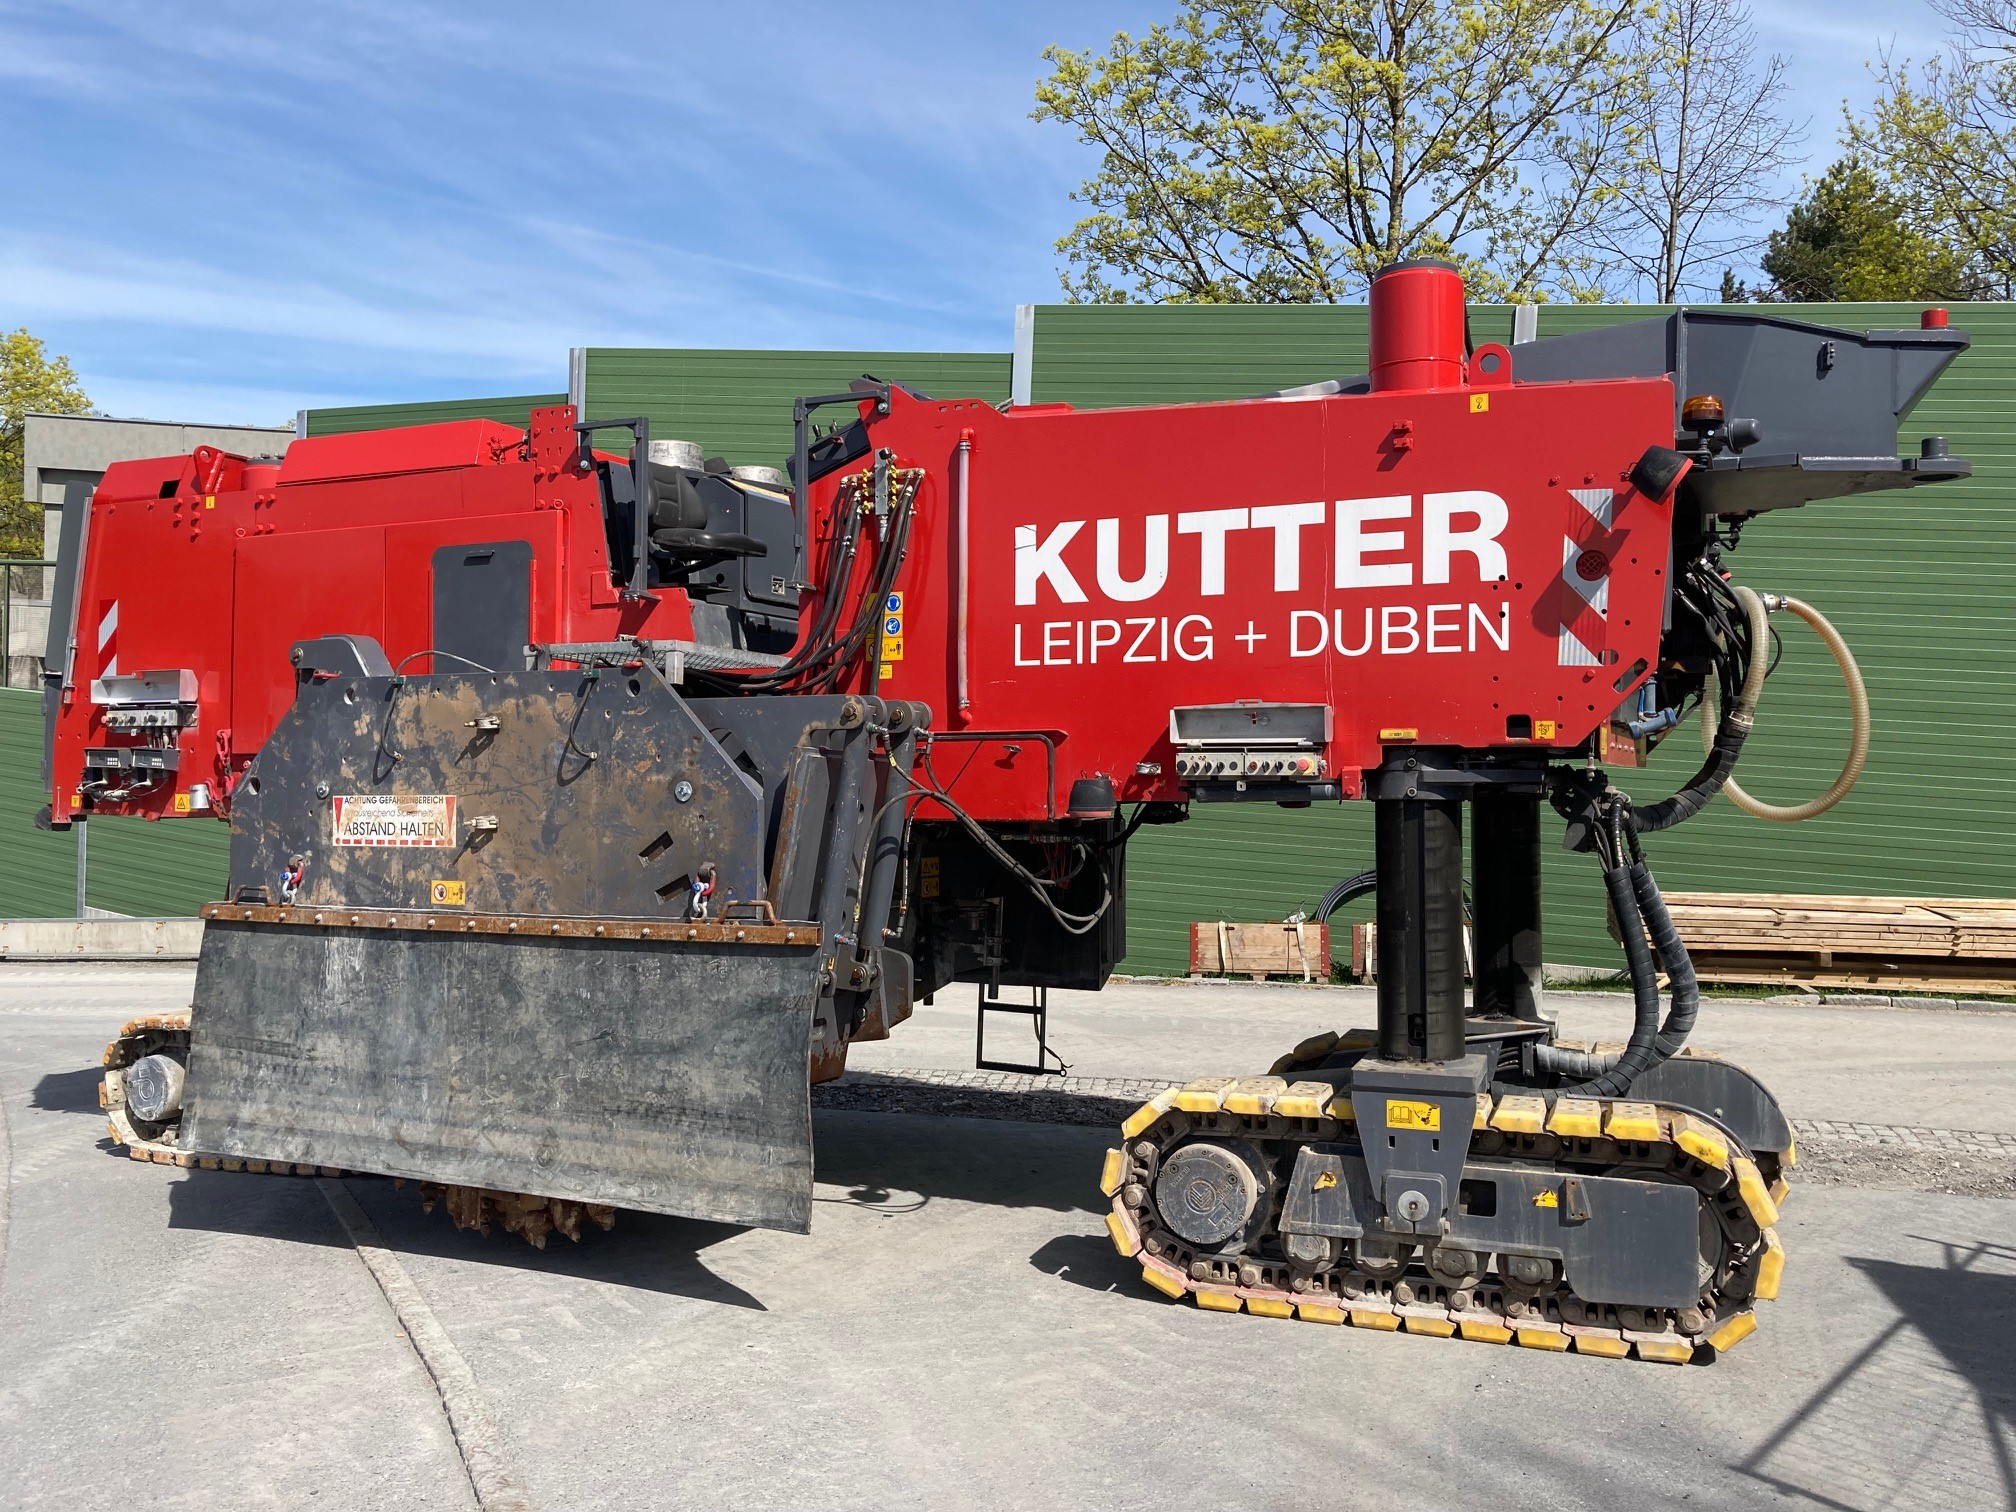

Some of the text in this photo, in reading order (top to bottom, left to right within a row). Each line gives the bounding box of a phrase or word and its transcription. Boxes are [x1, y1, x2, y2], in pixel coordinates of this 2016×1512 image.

[1014, 490, 1510, 605] KUTTER
[1014, 602, 1510, 667] LEIPZIG + DUBEN
[344, 796, 444, 804] ACHTUNG GEFAHRENBEREICH
[344, 821, 444, 836] ABSTAND HALTEN
